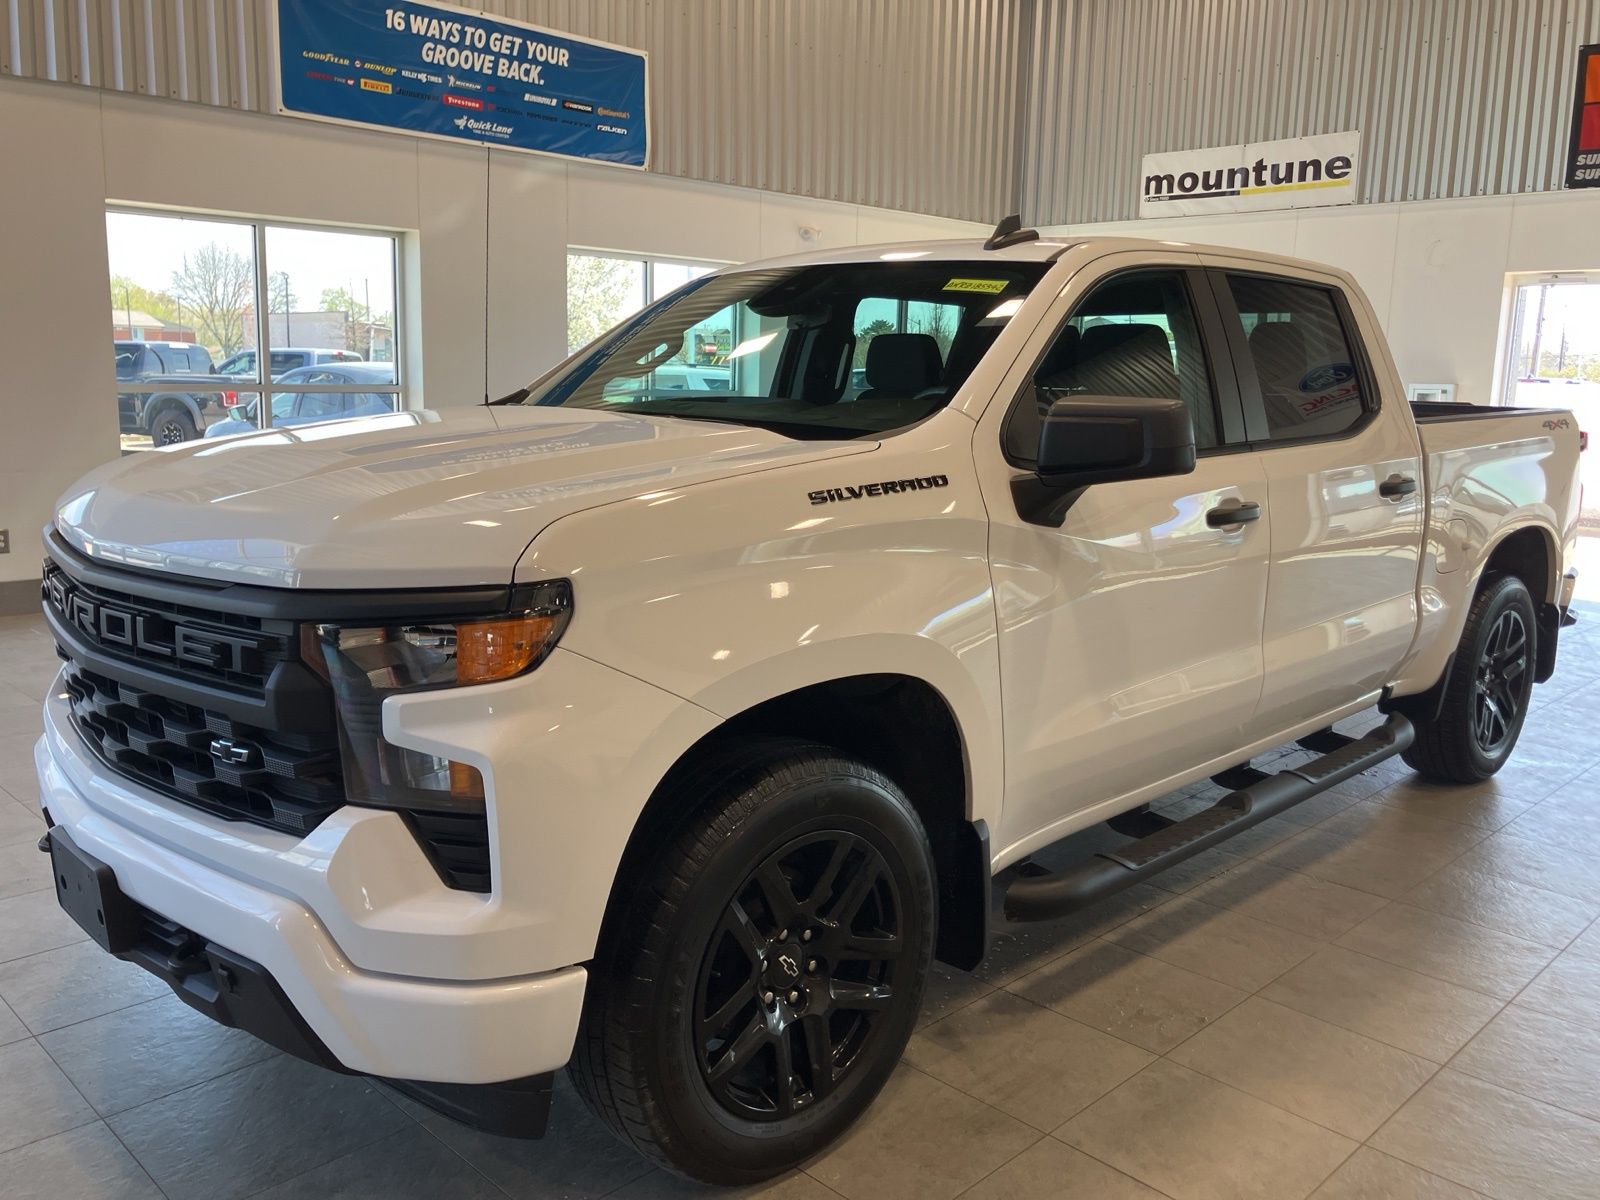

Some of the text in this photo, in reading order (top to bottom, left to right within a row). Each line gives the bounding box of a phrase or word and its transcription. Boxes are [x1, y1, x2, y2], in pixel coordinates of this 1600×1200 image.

[385, 8, 570, 68] 16 WAYS TO GET YOUR
[302, 50, 350, 66] GOODYEAR
[363, 62, 398, 76] DUNLOP
[421, 42, 546, 86] GROOVE BACK.
[467, 119, 513, 135] Quick Lane
[597, 124, 628, 135] FALKEN
[1144, 155, 1352, 196] mountune
[807, 474, 949, 505] SILVERADO
